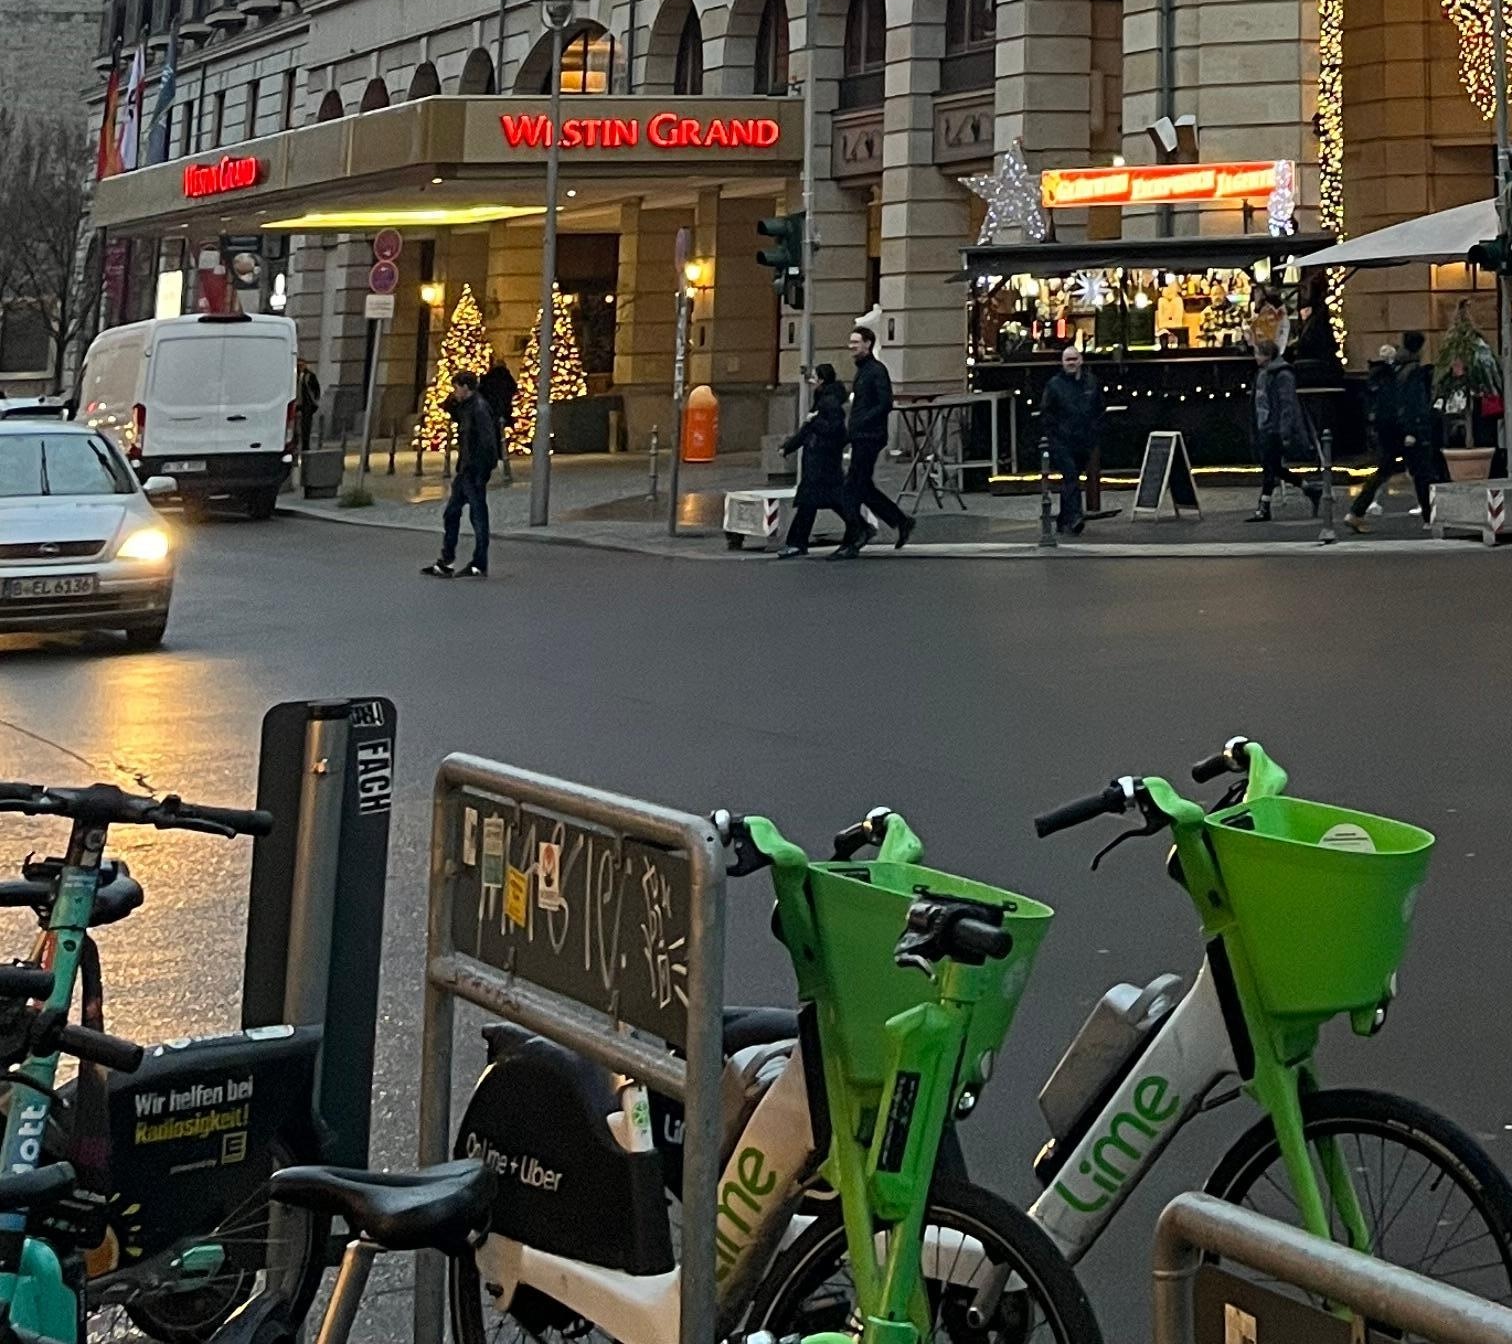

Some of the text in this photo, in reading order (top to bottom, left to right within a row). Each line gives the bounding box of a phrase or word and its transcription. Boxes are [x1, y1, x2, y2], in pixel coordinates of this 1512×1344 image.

[646, 112, 781, 148] GRAND
[359, 741, 391, 814] FACH
[135, 1074, 254, 1117] Wir helfen bei
[1054, 1075, 1181, 1213] Lime
[520, 1155, 563, 1192] Uber
